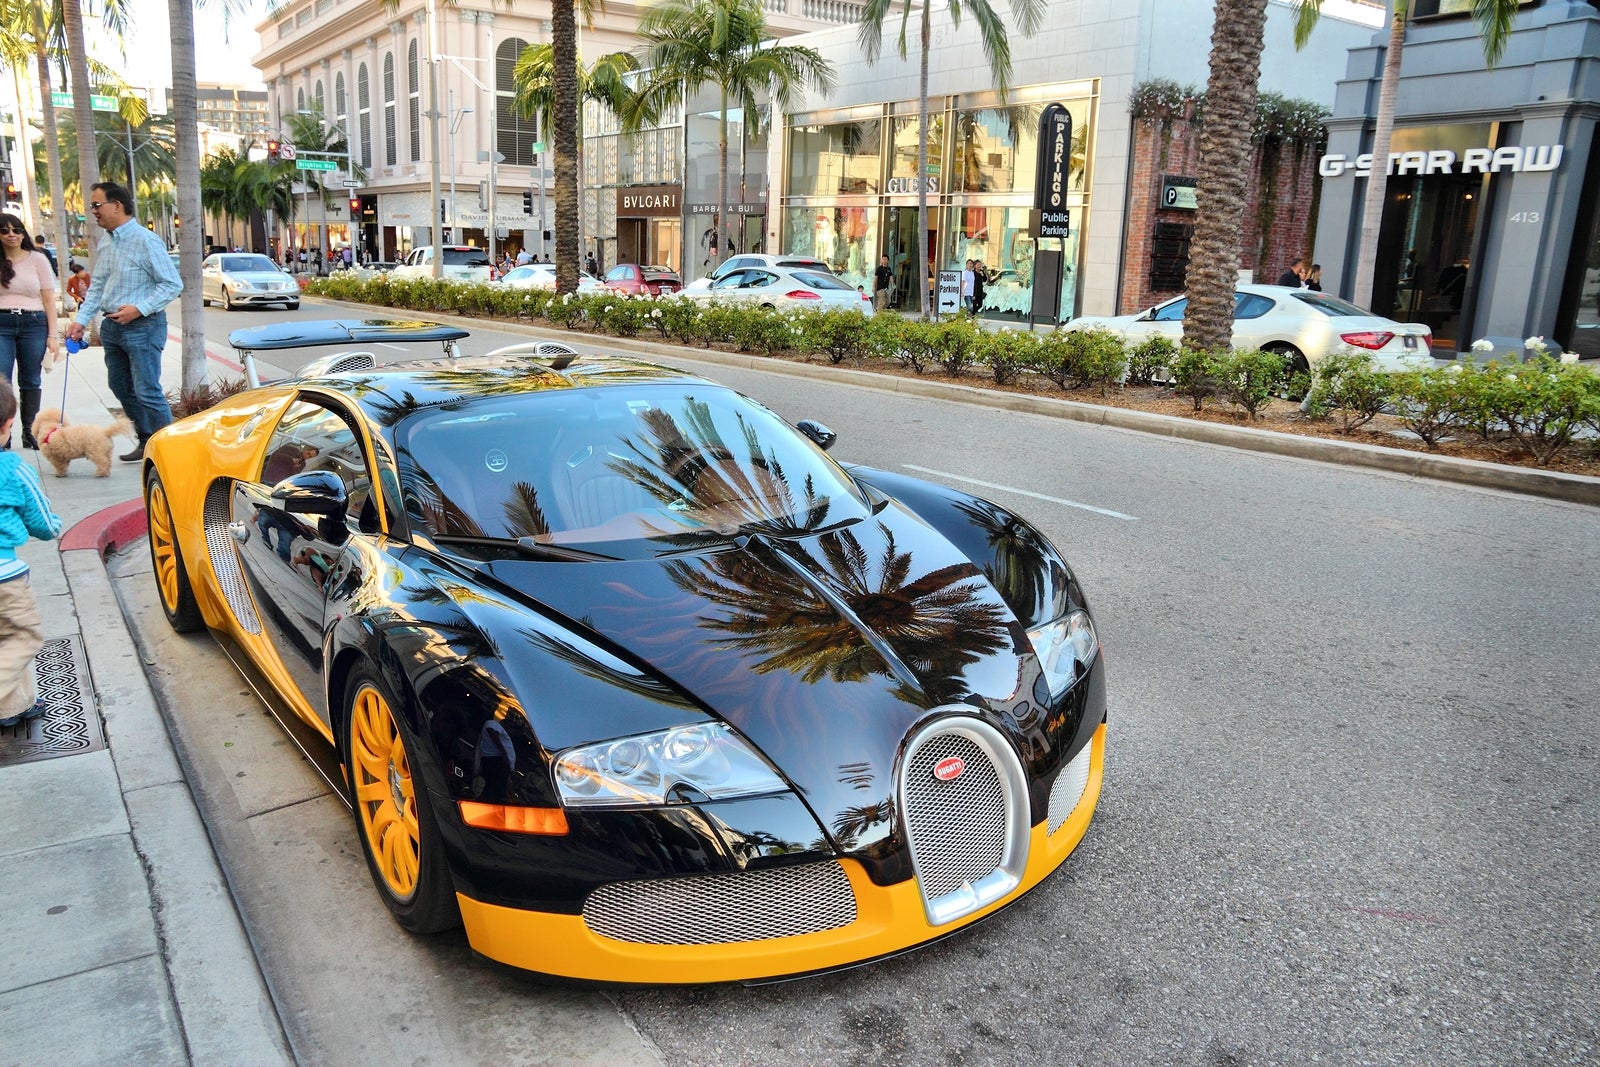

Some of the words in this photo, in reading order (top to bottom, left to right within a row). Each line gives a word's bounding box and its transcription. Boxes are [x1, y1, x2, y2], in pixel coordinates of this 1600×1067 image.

[95, 98, 113, 109] Way
[1054, 113, 1069, 123] PUBLIC
[1052, 122, 1065, 192] PARKING
[1461, 144, 1564, 174] RAW
[298, 161, 322, 169] Brighton
[887, 177, 938, 193] GUES
[623, 194, 676, 208] BVLGARI
[692, 205, 734, 213] BARBAA
[738, 204, 754, 212] BUI
[1042, 212, 1069, 223] Public
[1510, 211, 1540, 223] 413
[1041, 225, 1068, 237] Parking
[940, 273, 956, 282] Public
[940, 284, 959, 294] Parking
